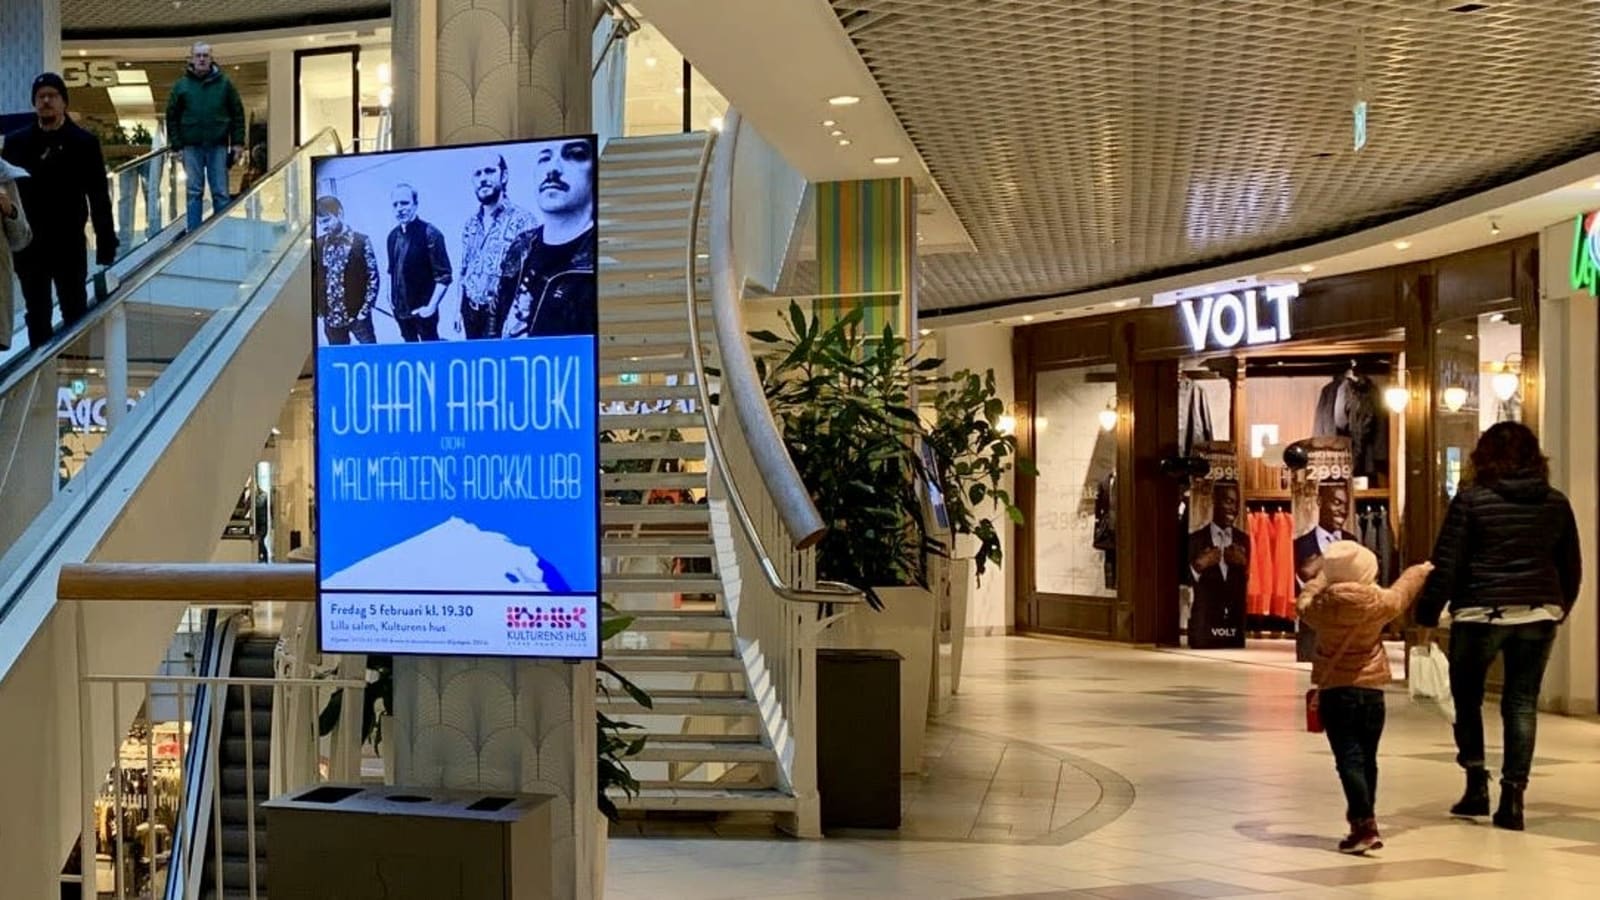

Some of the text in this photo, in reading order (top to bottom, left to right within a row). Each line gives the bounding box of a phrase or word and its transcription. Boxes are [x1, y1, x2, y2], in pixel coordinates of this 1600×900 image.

[1181, 282, 1299, 351] VOLT
[331, 355, 581, 436] JOHAN AIRIJOKI
[331, 451, 582, 501] MALMFÄLTENS ROCKKLUBB
[1306, 464, 1351, 481] 2999
[330, 603, 474, 619] Fredag 5 februari kl. 19.30
[330, 620, 446, 633] Lilla salen, Kulturens hus
[1211, 627, 1236, 637] VOLT
[507, 631, 587, 642] KULTURENS HUS
